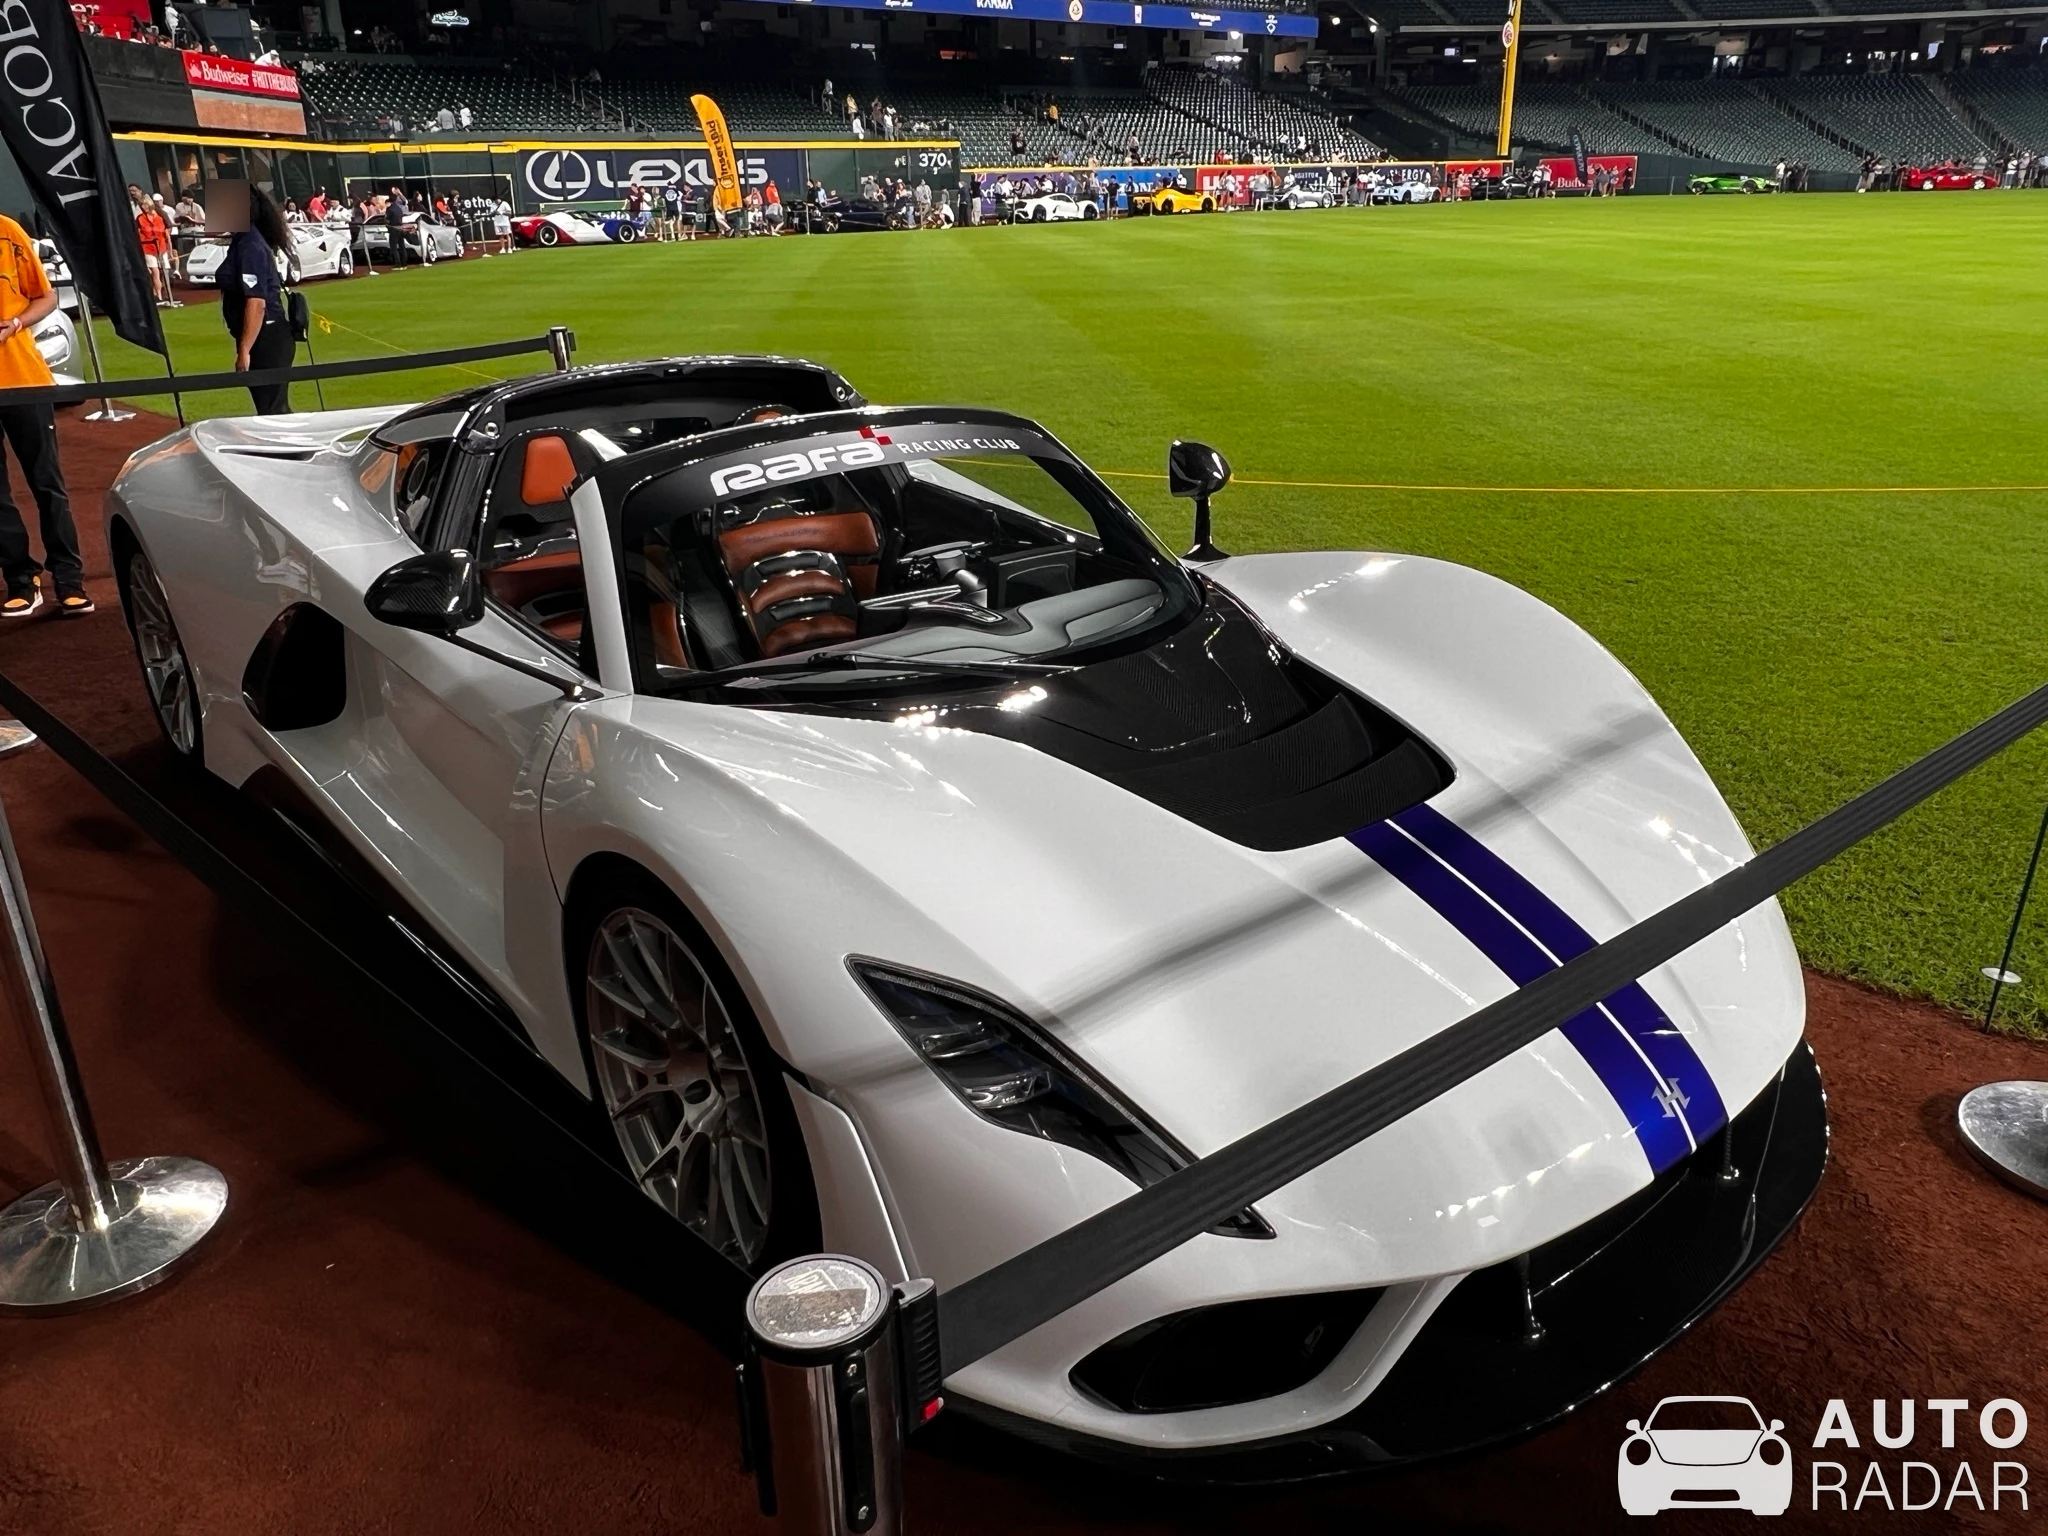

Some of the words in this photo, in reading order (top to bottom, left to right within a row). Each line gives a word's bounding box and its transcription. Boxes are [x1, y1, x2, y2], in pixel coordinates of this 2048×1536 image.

[200, 60, 249, 87] Budweiser
[918, 152, 947, 167] 370
[596, 158, 769, 188] LEXUS
[896, 438, 971, 454] RACING
[975, 437, 1021, 450] CLUB
